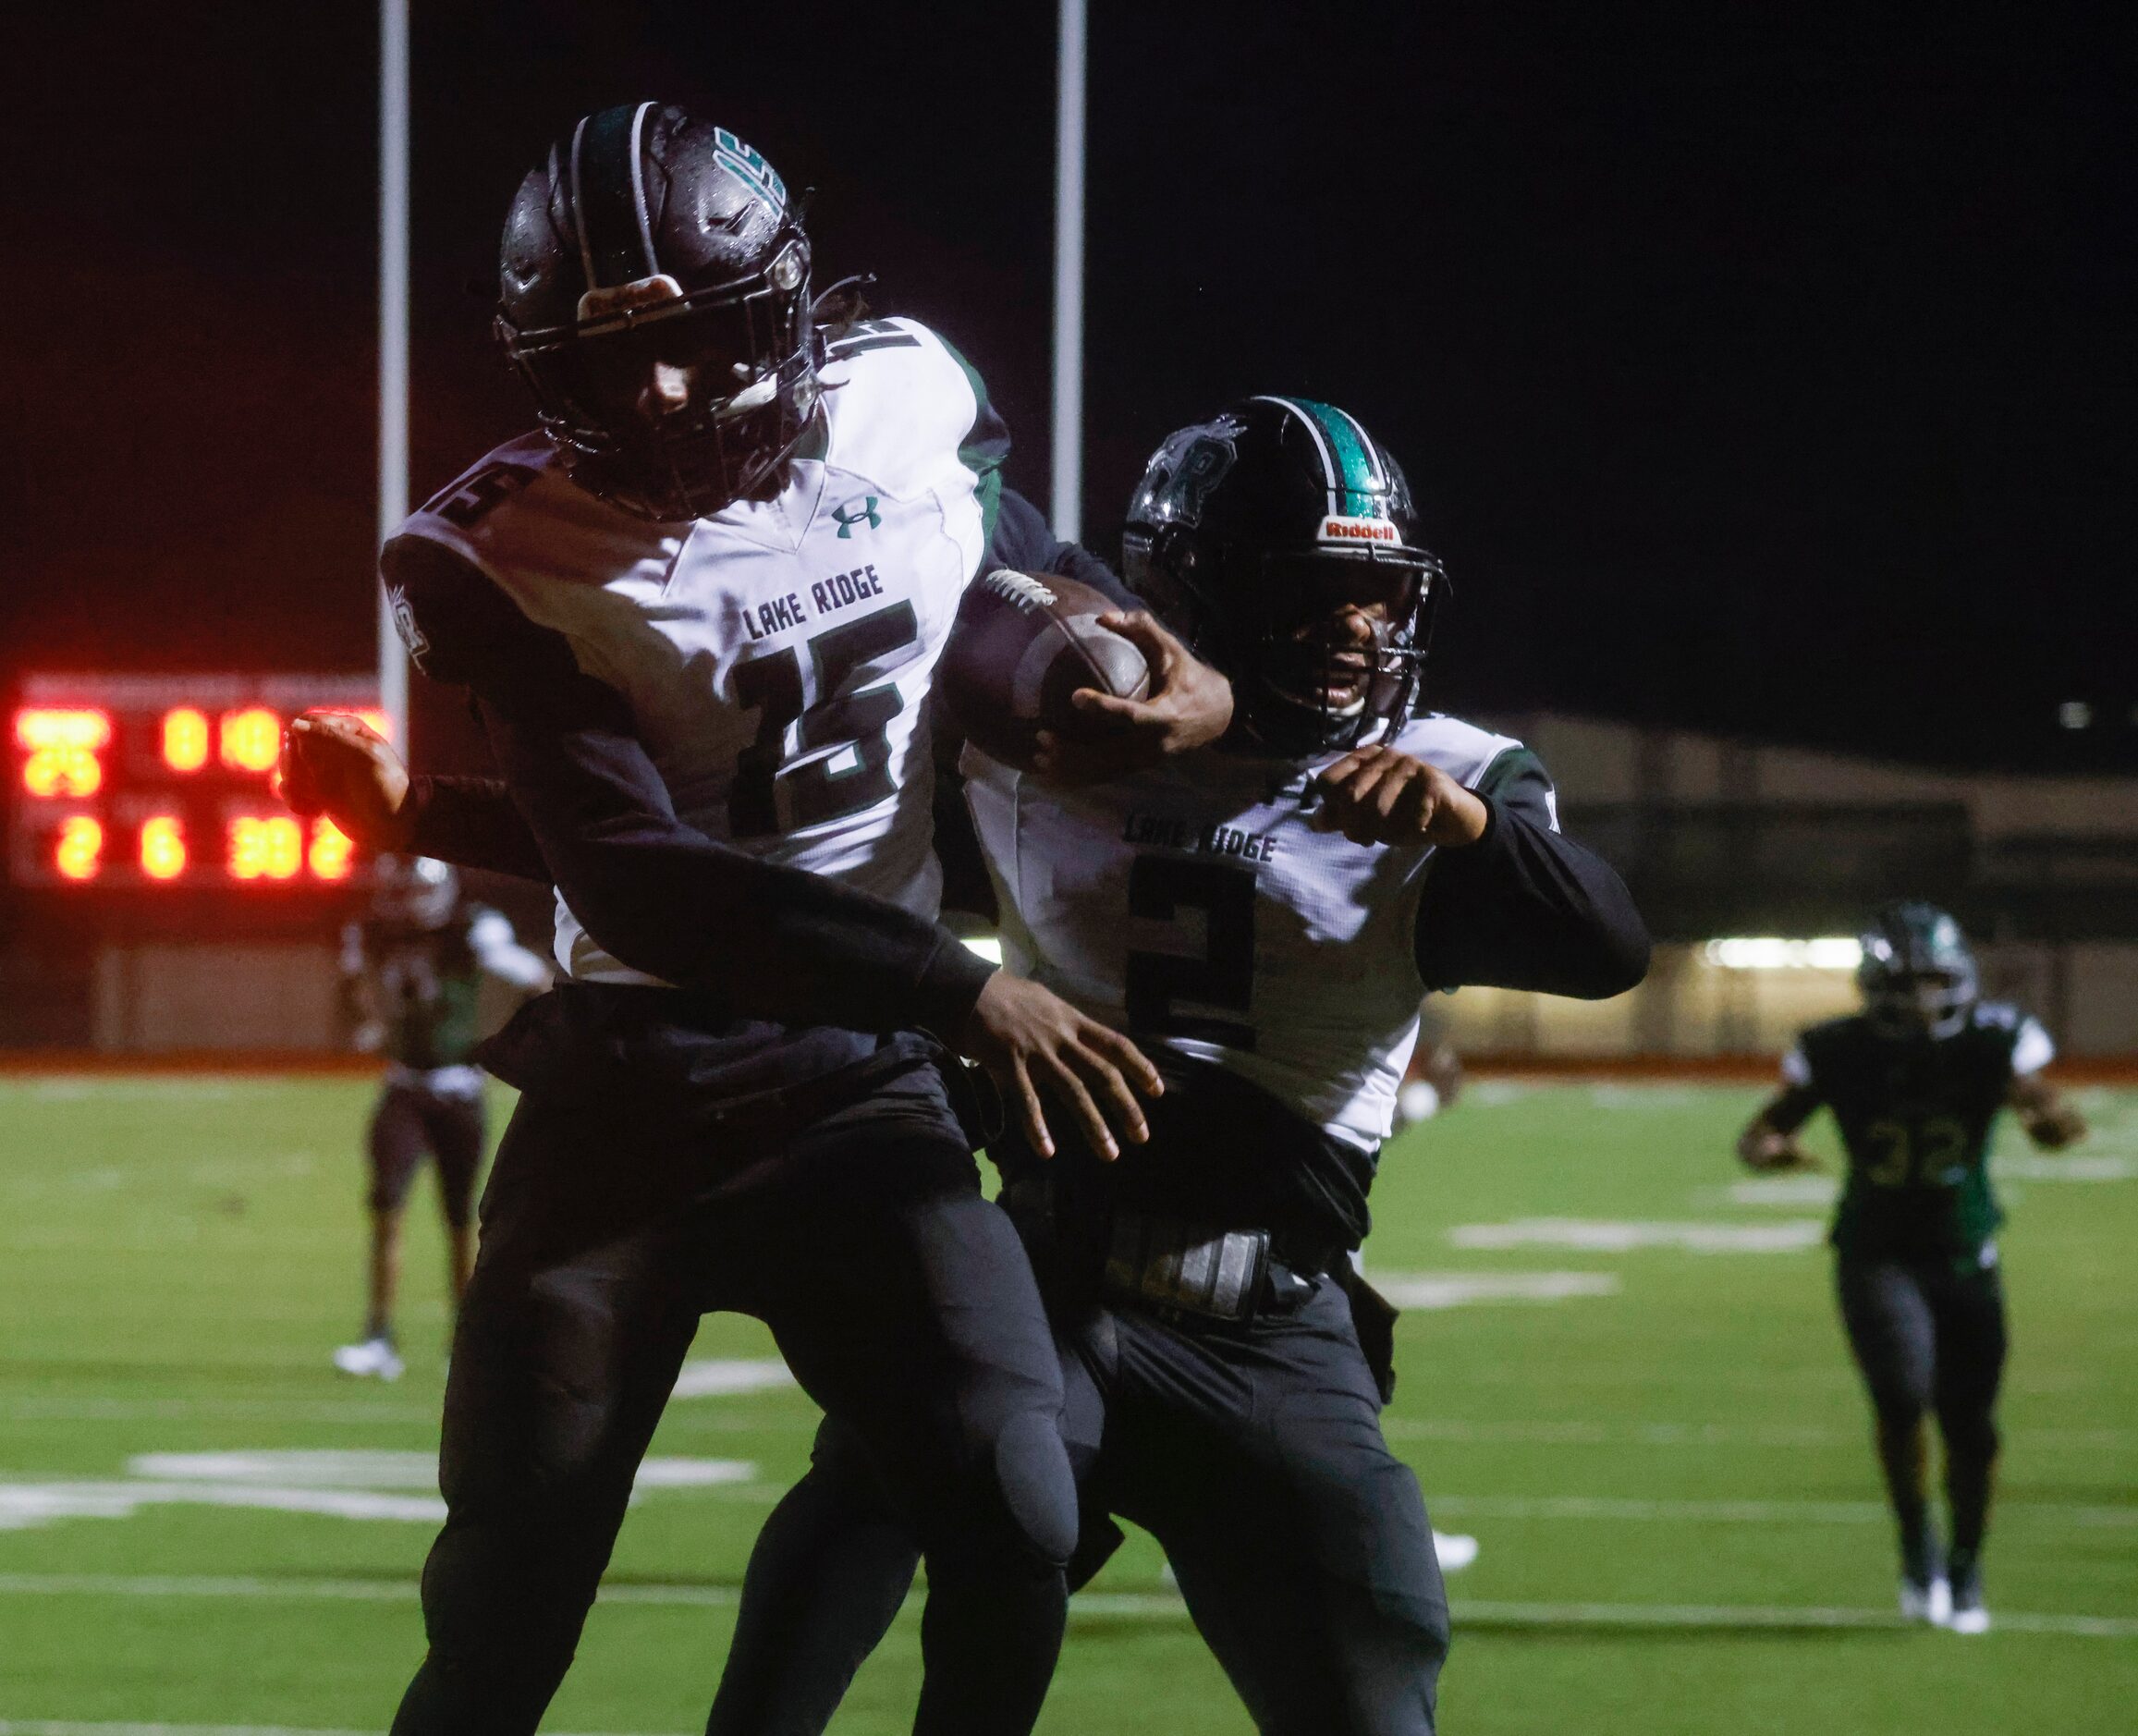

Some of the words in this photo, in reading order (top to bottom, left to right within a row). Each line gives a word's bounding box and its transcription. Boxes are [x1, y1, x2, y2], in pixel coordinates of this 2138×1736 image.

[1326, 522, 1393, 541] Riddell
[743, 593, 807, 641] LAKE
[811, 564, 884, 615] RIDGE
[727, 598, 918, 838] 15
[1122, 807, 1187, 848] LAKE
[1199, 823, 1277, 862] RIDGE
[1126, 852, 1257, 1051] 2
